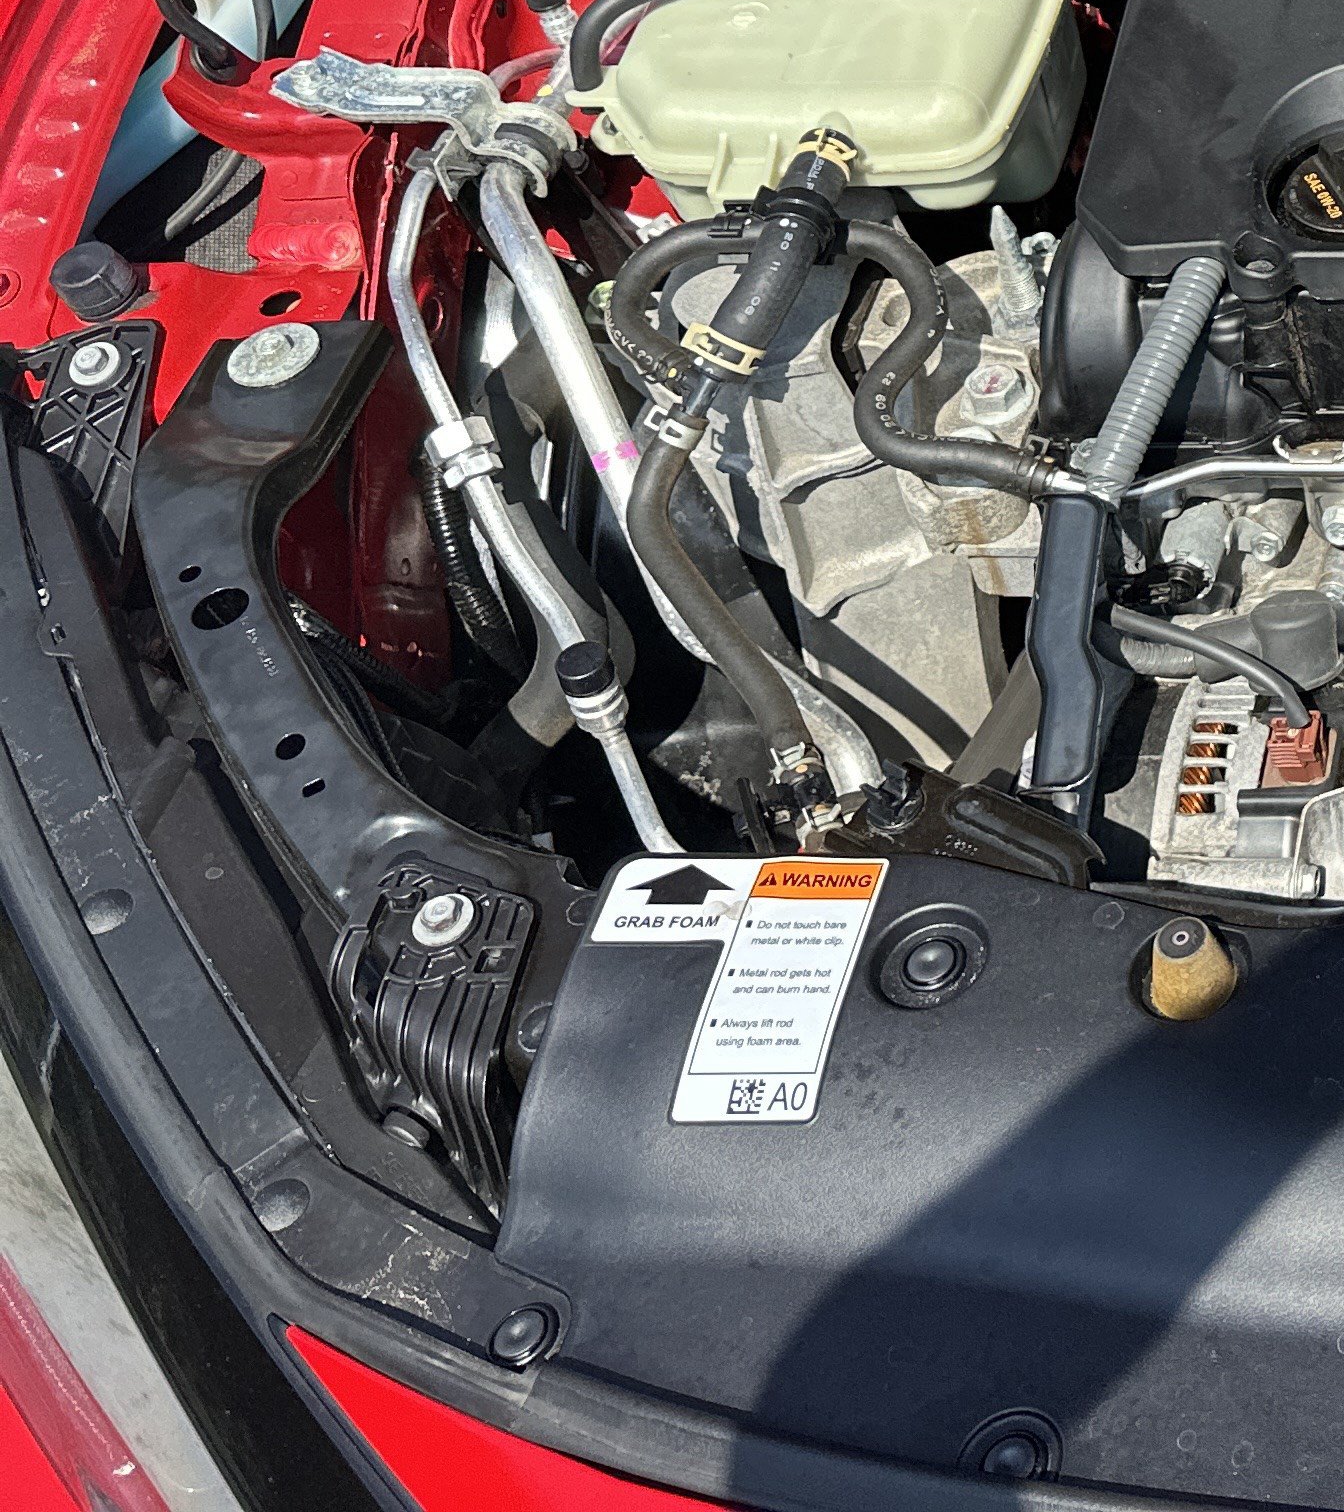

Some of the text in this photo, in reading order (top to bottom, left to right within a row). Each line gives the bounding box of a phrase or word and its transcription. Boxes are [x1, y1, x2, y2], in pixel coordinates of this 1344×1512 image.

[1304, 173, 1343, 218] SAE 0W-20
[782, 873, 872, 887] WARNING
[614, 916, 719, 928] GRAB FOAM
[757, 920, 847, 929] Do not touch bare
[751, 936, 778, 945] metal
[795, 936, 822, 945] white
[824, 936, 844, 947] clip.
[739, 968, 831, 979] Metal rod gets hot
[732, 985, 831, 994] and can burn hand.
[721, 1018, 794, 1029] Always lift rod
[716, 1036, 801, 1048] using foam area.
[767, 1082, 808, 1111] A0
